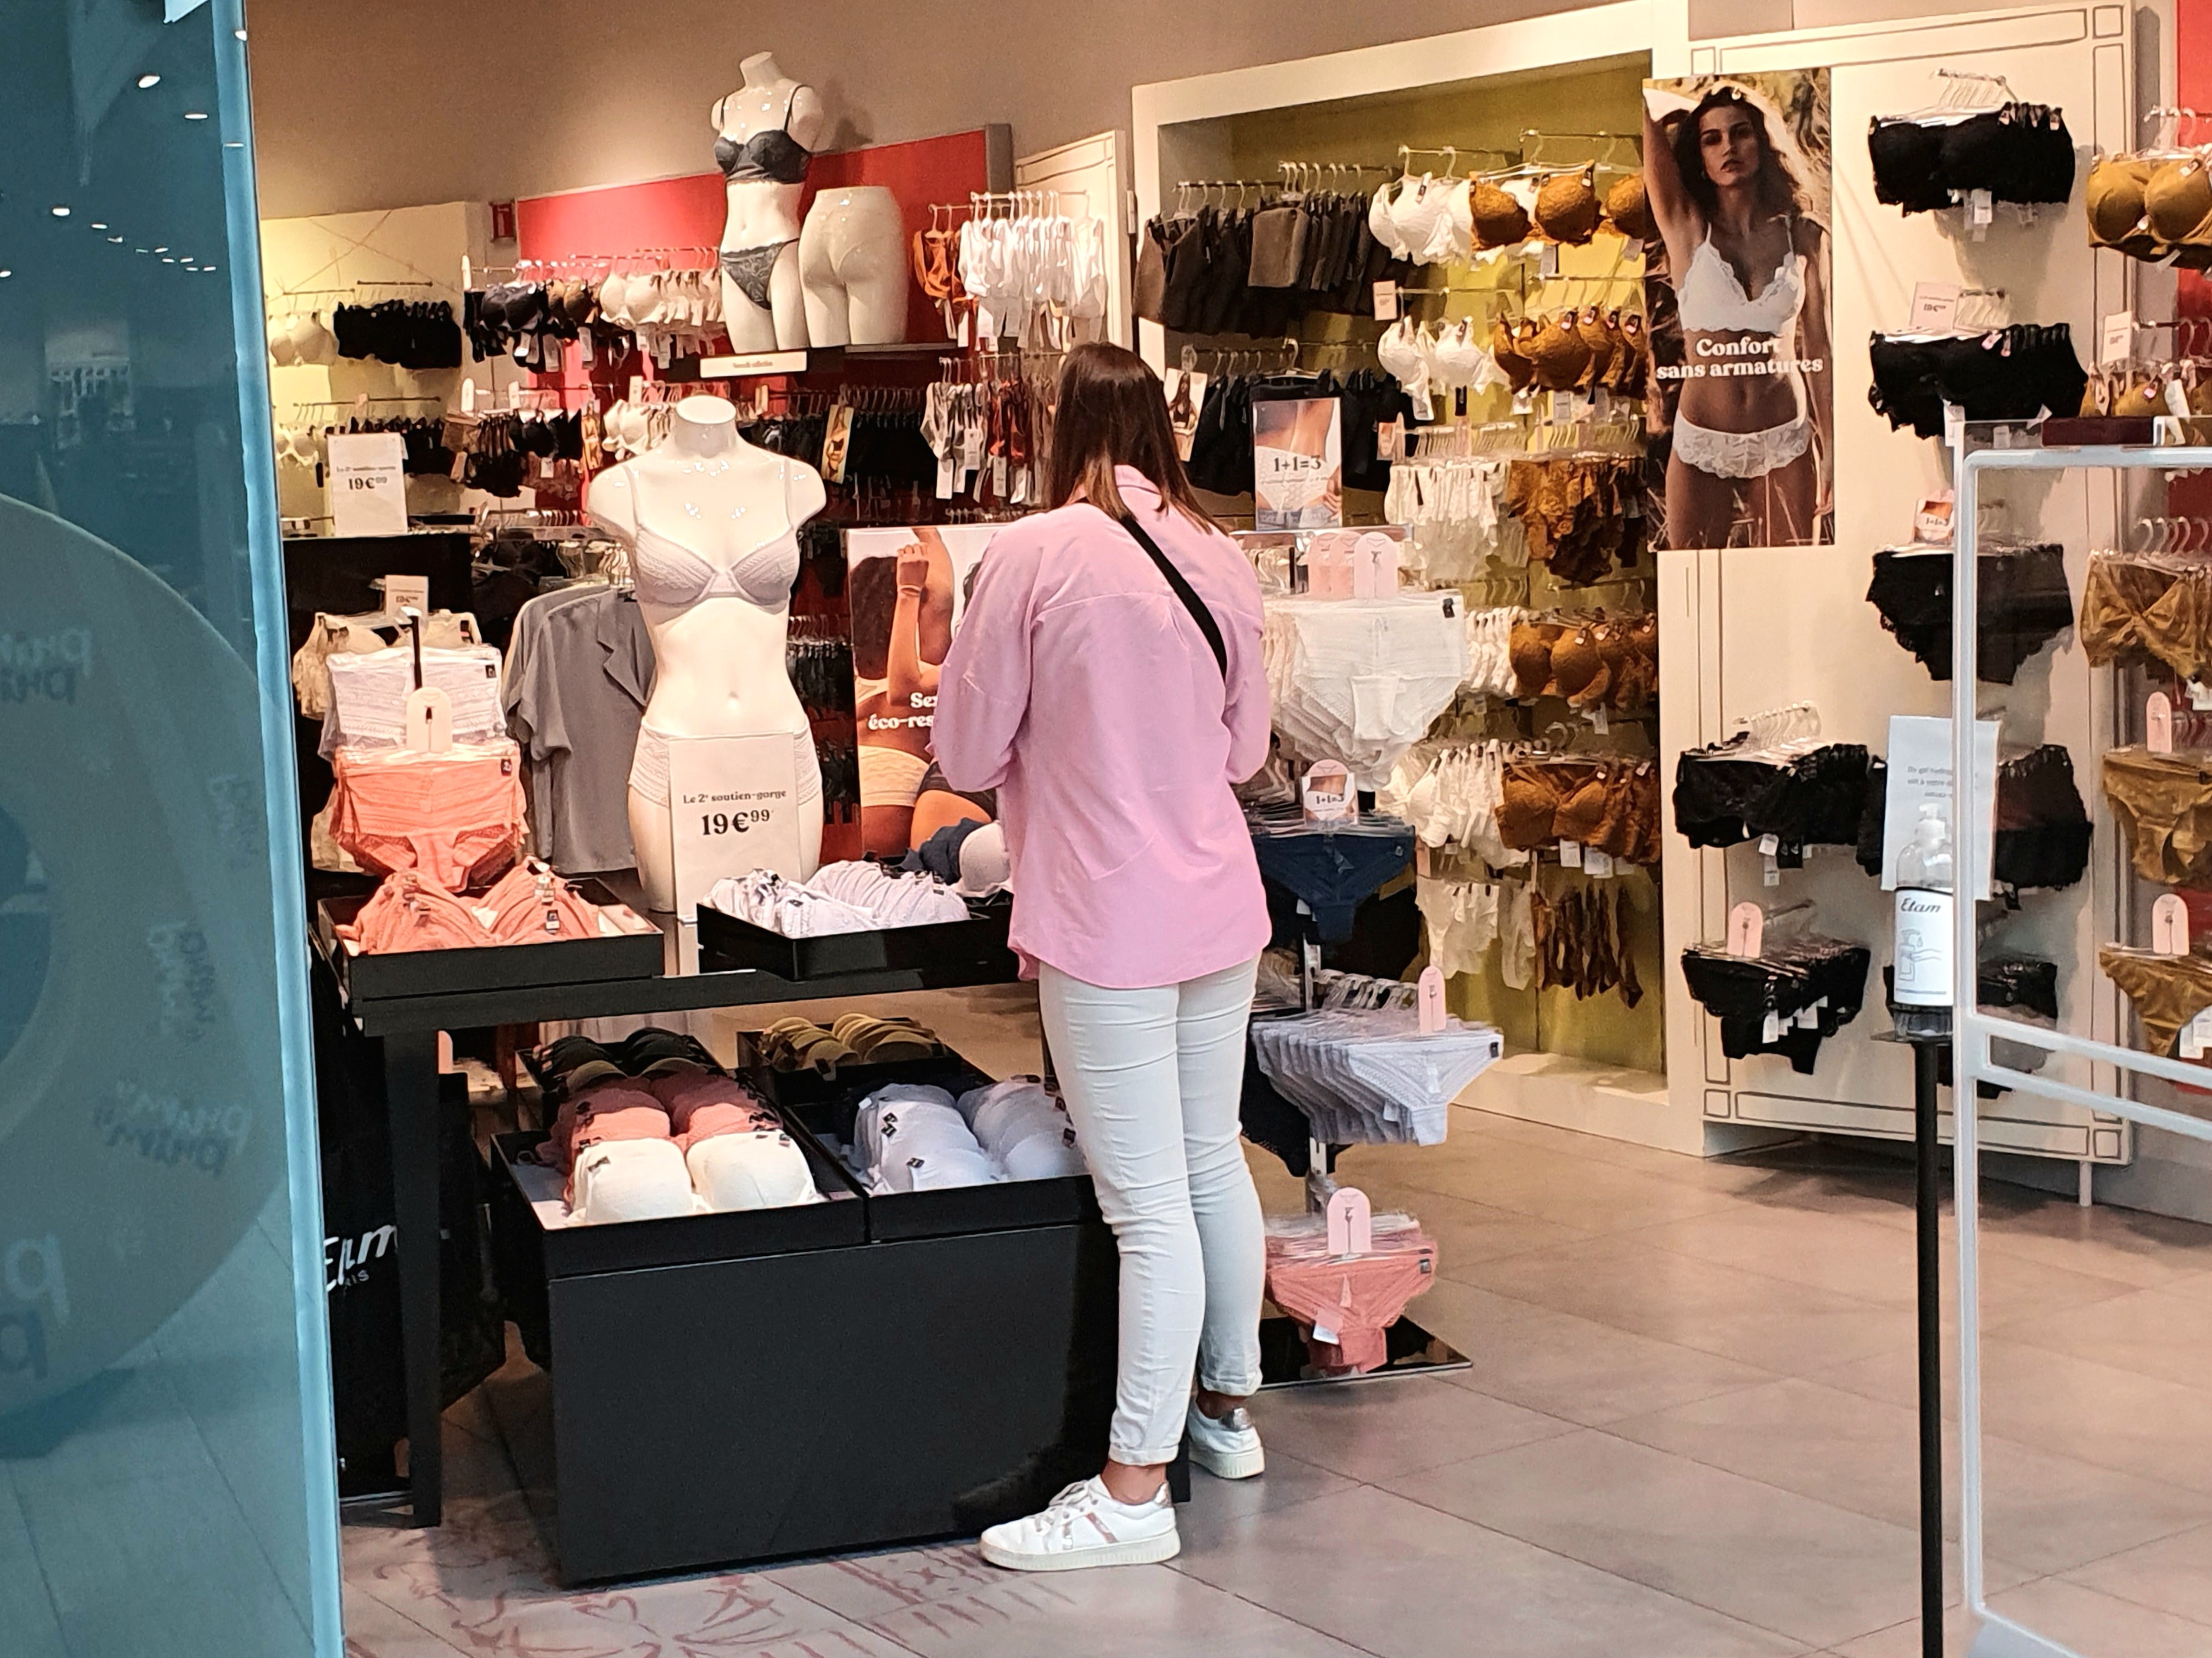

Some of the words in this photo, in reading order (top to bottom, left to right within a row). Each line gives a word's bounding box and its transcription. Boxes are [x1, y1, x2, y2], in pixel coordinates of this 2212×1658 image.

[1657, 363, 1706, 379] sans
[1709, 358, 1823, 377] armatures
[1274, 455, 1321, 472] 1+1=3
[868, 713, 935, 731] éco-res
[683, 794, 696, 805] Le
[711, 789, 787, 803] soutien-gorge
[1900, 897, 1942, 913] Etam
